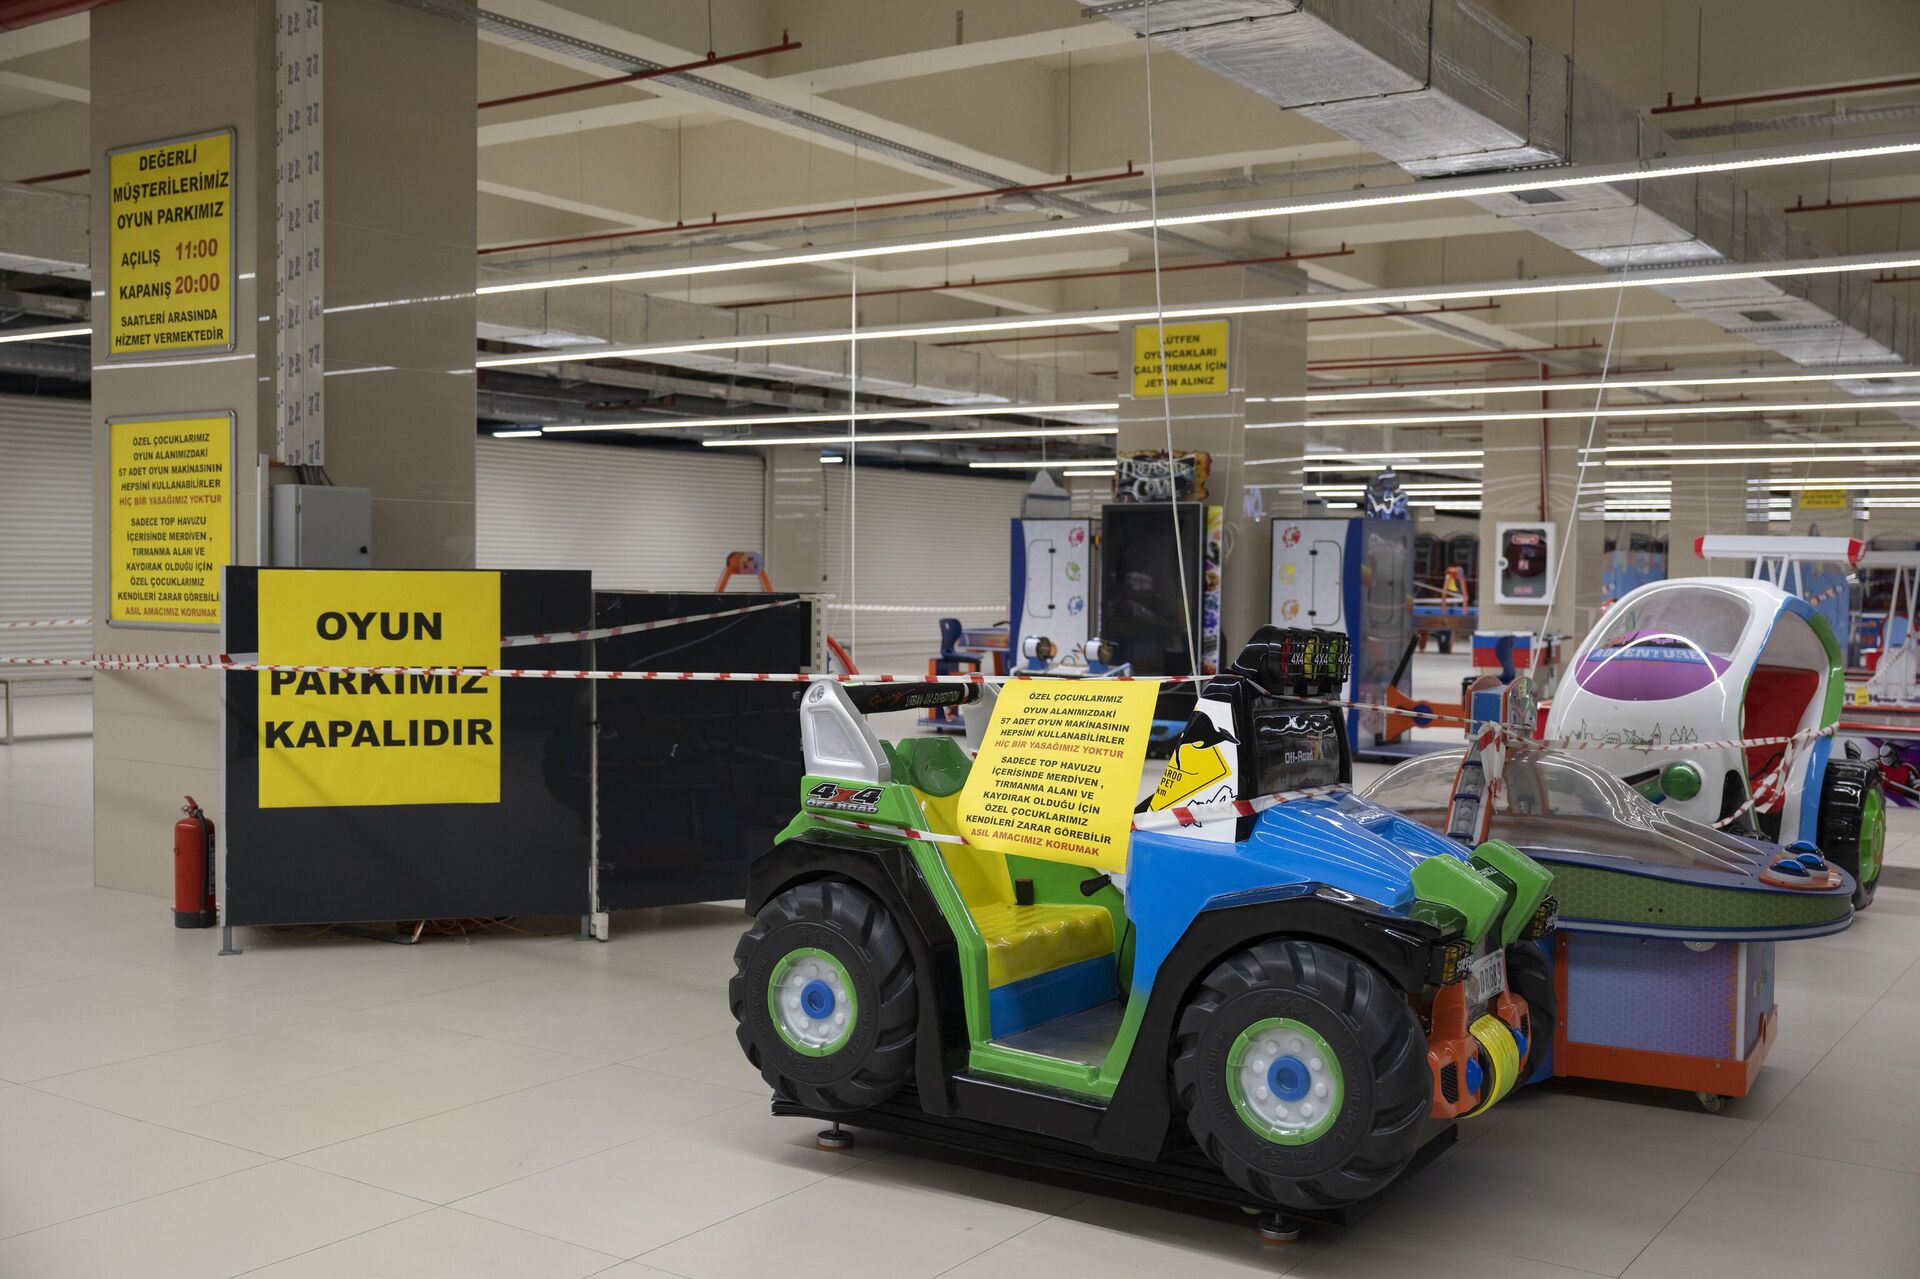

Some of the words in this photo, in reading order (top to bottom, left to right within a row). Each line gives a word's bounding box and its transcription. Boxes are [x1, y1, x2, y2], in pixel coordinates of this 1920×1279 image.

[139, 144, 197, 171] DEĞERLİ
[114, 169, 229, 203] MÜŞTERİLERİMİZ
[118, 210, 152, 229] OYUN
[158, 201, 224, 224] PARKIMIZ
[121, 250, 160, 269] AÇILIŞ
[176, 238, 218, 260] 11:00
[120, 281, 171, 300] KAPANIŞ
[175, 272, 219, 294] 20:00
[121, 310, 165, 326] SAATLERİ
[168, 309, 217, 323] ARASINDA
[116, 332, 151, 346] HİZMET
[154, 326, 223, 344] VERMEKTEDİR
[1134, 362, 1201, 376] ÇALIŞIRMAK
[1206, 361, 1226, 371] İÇİN
[1180, 377, 1214, 386] ALINIZ
[133, 436, 151, 446] ÖZEL
[153, 433, 210, 446] ÇOCUKLARIMIZ
[134, 450, 153, 461] OYUN
[156, 446, 208, 460] ALANIMIZDAKİ
[119, 468, 127, 477] 57
[129, 467, 147, 476] ADET
[149, 465, 169, 475] OYUN
[171, 463, 222, 474] MAKİNASININ
[121, 479, 150, 491] HEPSİNİ
[152, 479, 221, 489] KULLANABİLİRLER
[120, 495, 132, 507] HİÇ
[134, 494, 147, 505] BİR
[149, 494, 188, 505] YASAĞIMIZ
[190, 495, 222, 504] YOKTUR
[131, 517, 158, 526] SADECE
[160, 517, 175, 526] TOP
[178, 517, 206, 525] HAVUZU
[127, 530, 167, 542] İÇERİSİNDE
[169, 530, 206, 541] MERDİVEN
[132, 547, 170, 556] TIRMANMA
[173, 547, 193, 556] ALANI
[195, 547, 205, 556] VE
[126, 562, 162, 571] KAYDIRAK
[165, 561, 194, 571] OLDUĞU
[195, 561, 213, 572] İÇİN
[130, 576, 149, 586] ÖZEL
[150, 577, 205, 588] ÇOCUKLARIMIZ
[118, 589, 156, 601] KENDİLERİ
[158, 592, 182, 601] ZARAR
[184, 590, 221, 602] GÖREBİLİ
[125, 607, 142, 616] ASIL
[144, 607, 180, 617] AMACIMIZ
[181, 607, 217, 618] KORUMAK
[317, 612, 442, 641] OYUN
[271, 666, 488, 696] PARKIMIZ
[1054, 693, 1123, 704] ÇOCUKLARIMIZ
[1023, 706, 1048, 715] OYUN
[1050, 708, 1116, 718] ALANIMIZDAKİ
[265, 719, 494, 748] KAPALIDIR
[1038, 718, 1062, 727] OYUN
[1064, 719, 1130, 732] MAKİNASININ
[1000, 728, 1035, 737] HEPSİNİ
[1037, 729, 1125, 745] KULLANABİLİRLER
[994, 739, 1010, 749] HİÇ
[1012, 739, 1028, 748] BİR
[1030, 741, 1080, 753] YASAĞIMIZ
[1083, 747, 1123, 758] YOKTUR
[1001, 756, 1036, 766] SADECE
[1039, 759, 1058, 768] TOP
[1060, 762, 1101, 774] HAVUZU
[992, 766, 1044, 778] İÇERİSİNDE
[1046, 772, 1098, 787] MERDİVEN
[995, 780, 1044, 793] TIRMANMA
[1047, 786, 1077, 797] ALANI
[1080, 791, 1094, 800] VE
[983, 790, 1030, 804] KAYDIRAK
[1033, 796, 1075, 810] OLDUĞU
[1078, 803, 1100, 815] İÇİN
[985, 803, 1008, 813] ÖZEL
[1011, 807, 1088, 826] ÇOCUKLARIMIZ
[966, 814, 1014, 828] KENDİLERİ
[1017, 821, 1051, 833] ZARAR
[1054, 827, 1111, 844] GÖREBİLİR
[971, 828, 990, 837] ASIL
[992, 830, 1042, 846] AMACIMIZ
[1046, 839, 1099, 856] KORUMAK
